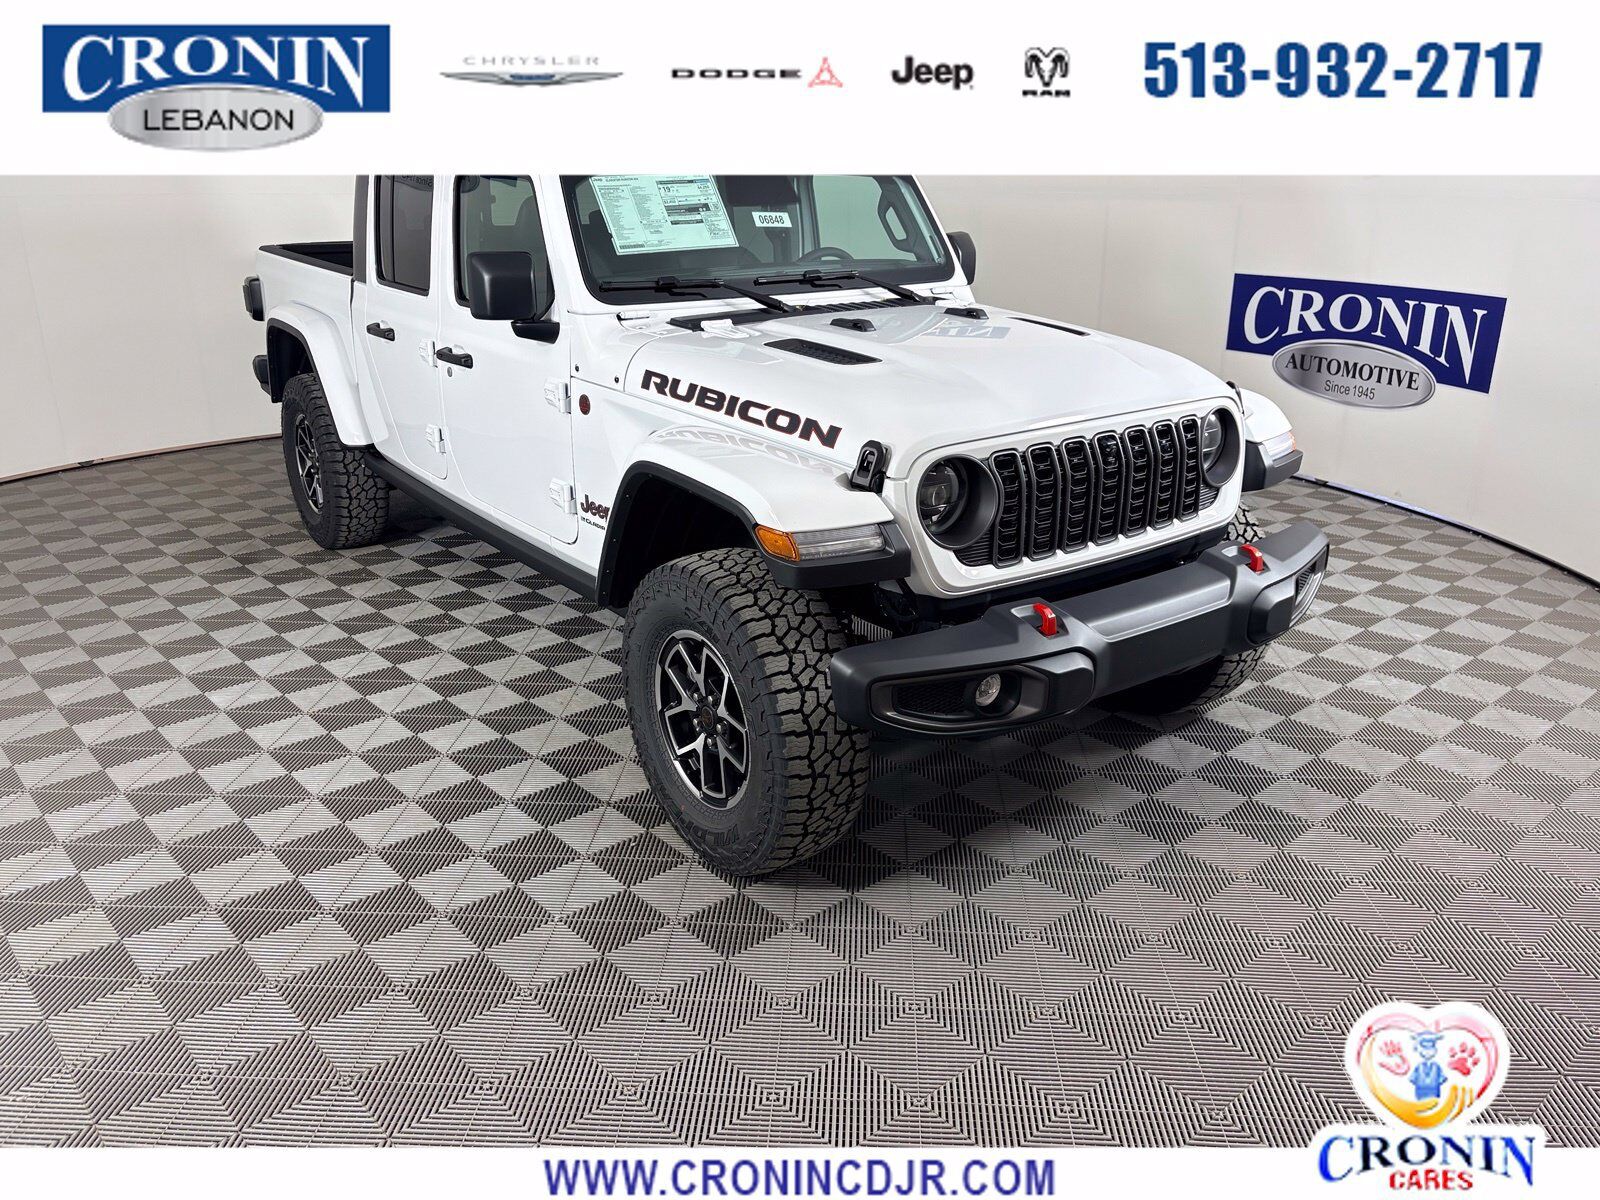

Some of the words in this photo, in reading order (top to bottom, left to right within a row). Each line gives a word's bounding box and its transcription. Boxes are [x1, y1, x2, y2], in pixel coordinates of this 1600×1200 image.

[758, 215, 785, 225] 06848
[1243, 285, 1488, 385] CRONIN
[1284, 352, 1420, 391] AUTOMOTIVE
[1324, 379, 1350, 395] Since
[1352, 385, 1376, 400] 1945
[640, 369, 843, 450] RUBICON
